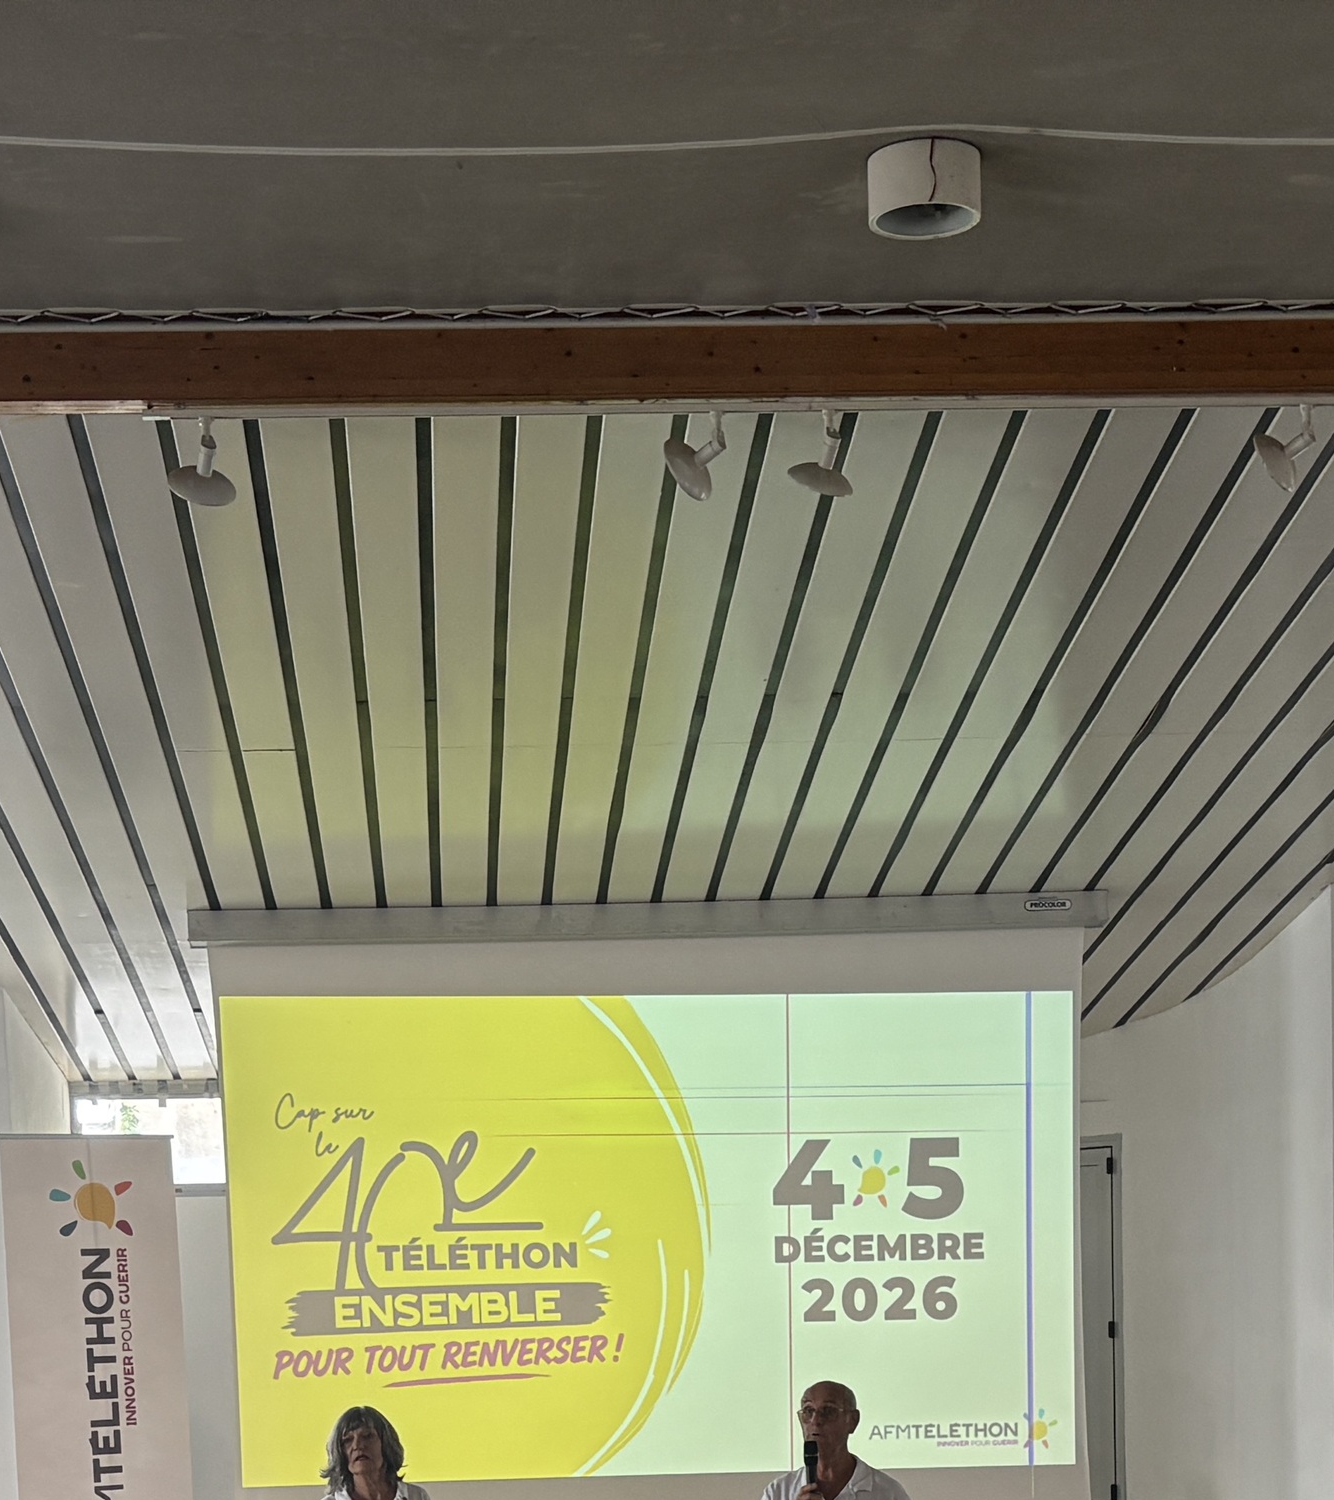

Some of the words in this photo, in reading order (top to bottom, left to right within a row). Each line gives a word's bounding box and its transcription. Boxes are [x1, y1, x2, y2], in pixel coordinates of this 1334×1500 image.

[275, 1093, 325, 1132] Cap
[332, 1106, 374, 1123] sur
[316, 1131, 339, 1157] le
[377, 1237, 578, 1271] TÉLÉTHON
[774, 1227, 984, 1263] DÉCEMBRE
[334, 1290, 561, 1328] ENSEMBLE
[801, 1275, 958, 1322] 2026
[121, 1308, 133, 1352] POUR
[273, 1347, 354, 1380] POUR
[365, 1343, 436, 1374] TOUT
[122, 1355, 137, 1426] INNOVER
